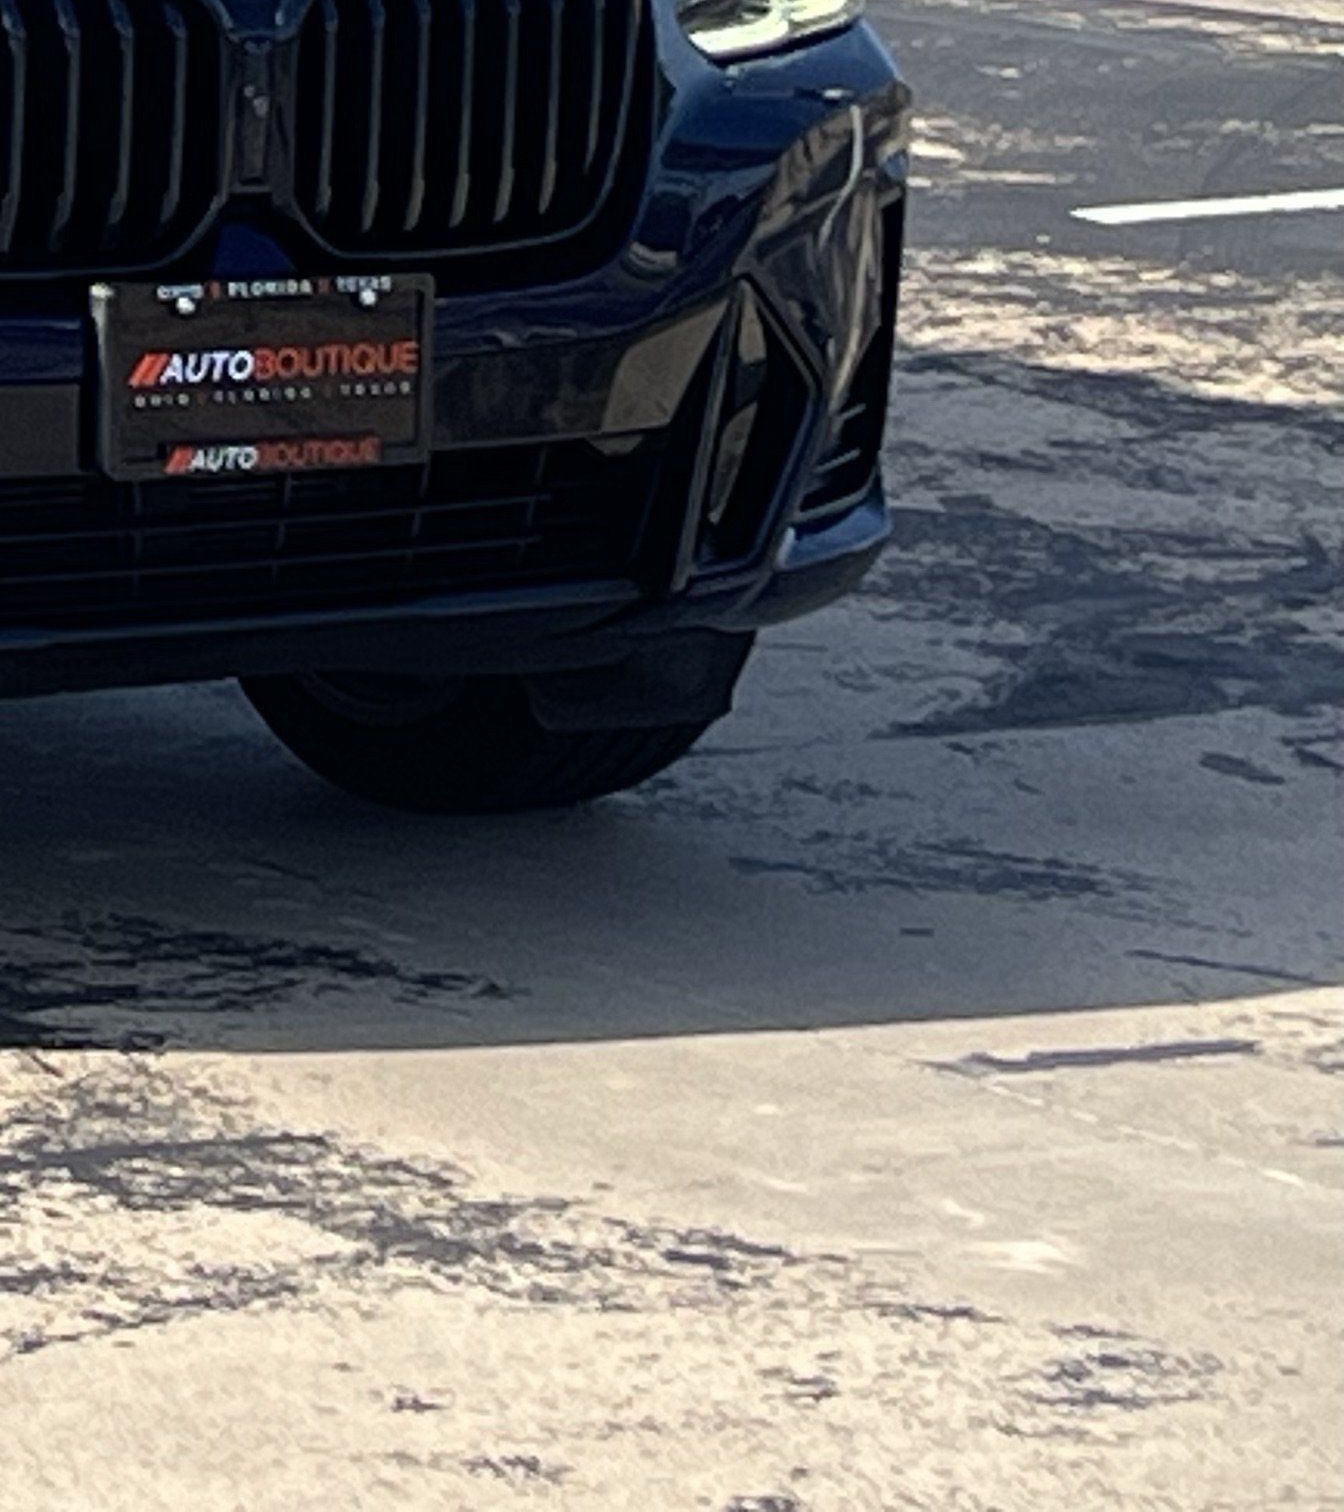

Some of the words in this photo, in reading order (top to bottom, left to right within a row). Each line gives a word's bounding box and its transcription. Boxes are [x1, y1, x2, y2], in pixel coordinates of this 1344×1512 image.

[228, 279, 313, 297] FLORIDA
[159, 341, 418, 384] AUTOBOUTIQUE
[189, 439, 379, 473] AUTOBOUTIQUE
